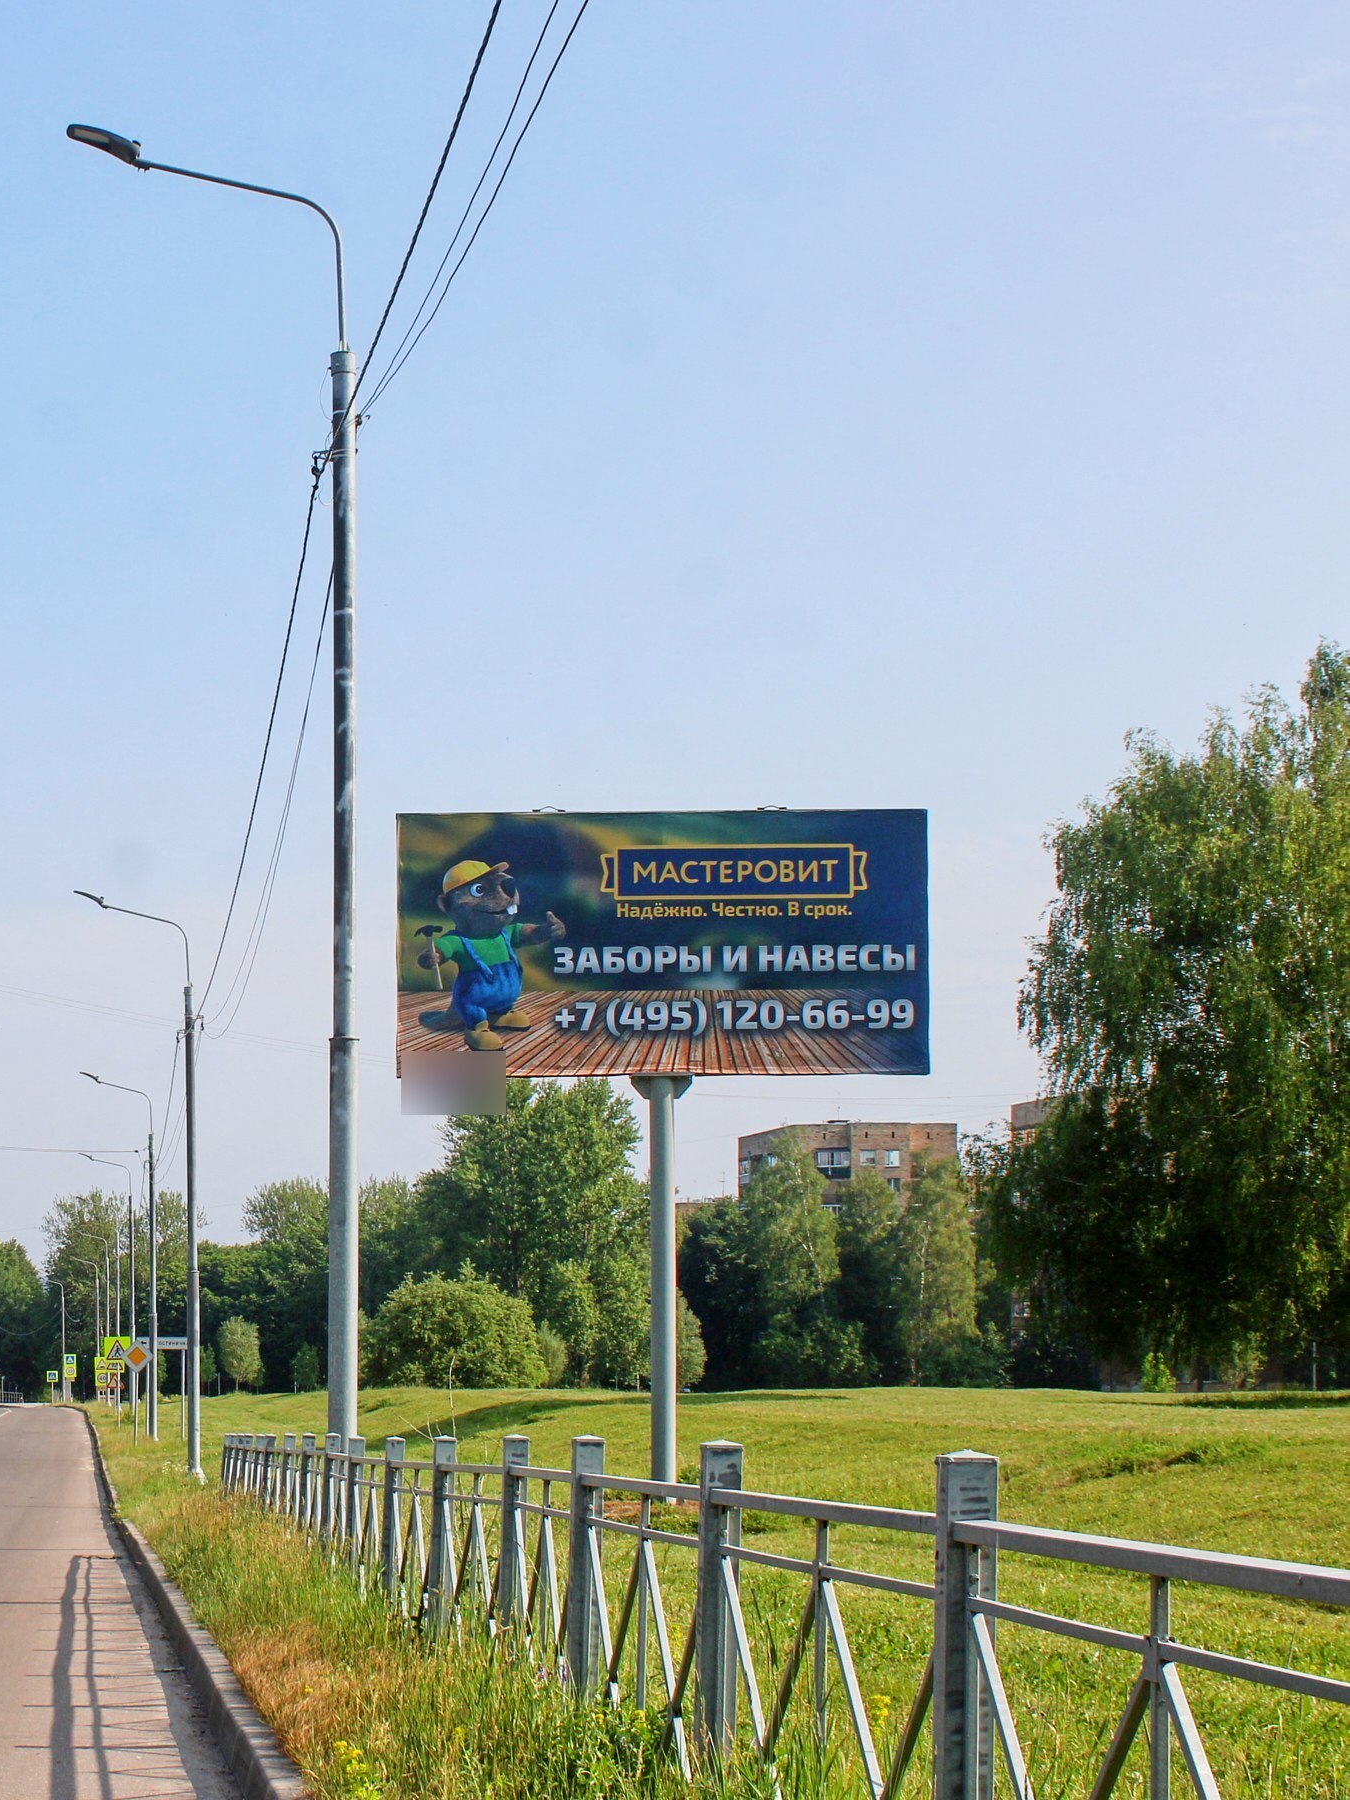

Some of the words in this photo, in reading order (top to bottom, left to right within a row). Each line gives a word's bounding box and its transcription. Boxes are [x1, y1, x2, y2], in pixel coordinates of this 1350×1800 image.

[633, 859, 839, 884] МАСТЕРОВИТ
[616, 902, 707, 920] Надёжно.
[711, 902, 783, 917] Честно.
[787, 901, 800, 916] В
[803, 904, 853, 919] срок.
[553, 945, 712, 974] ЗАБОРЫ
[722, 945, 748, 973] И
[758, 944, 916, 972] НАВЕСЫ
[554, 1001, 597, 1031] +7
[606, 998, 707, 1036] (495)
[716, 999, 915, 1030] 120-66-99
